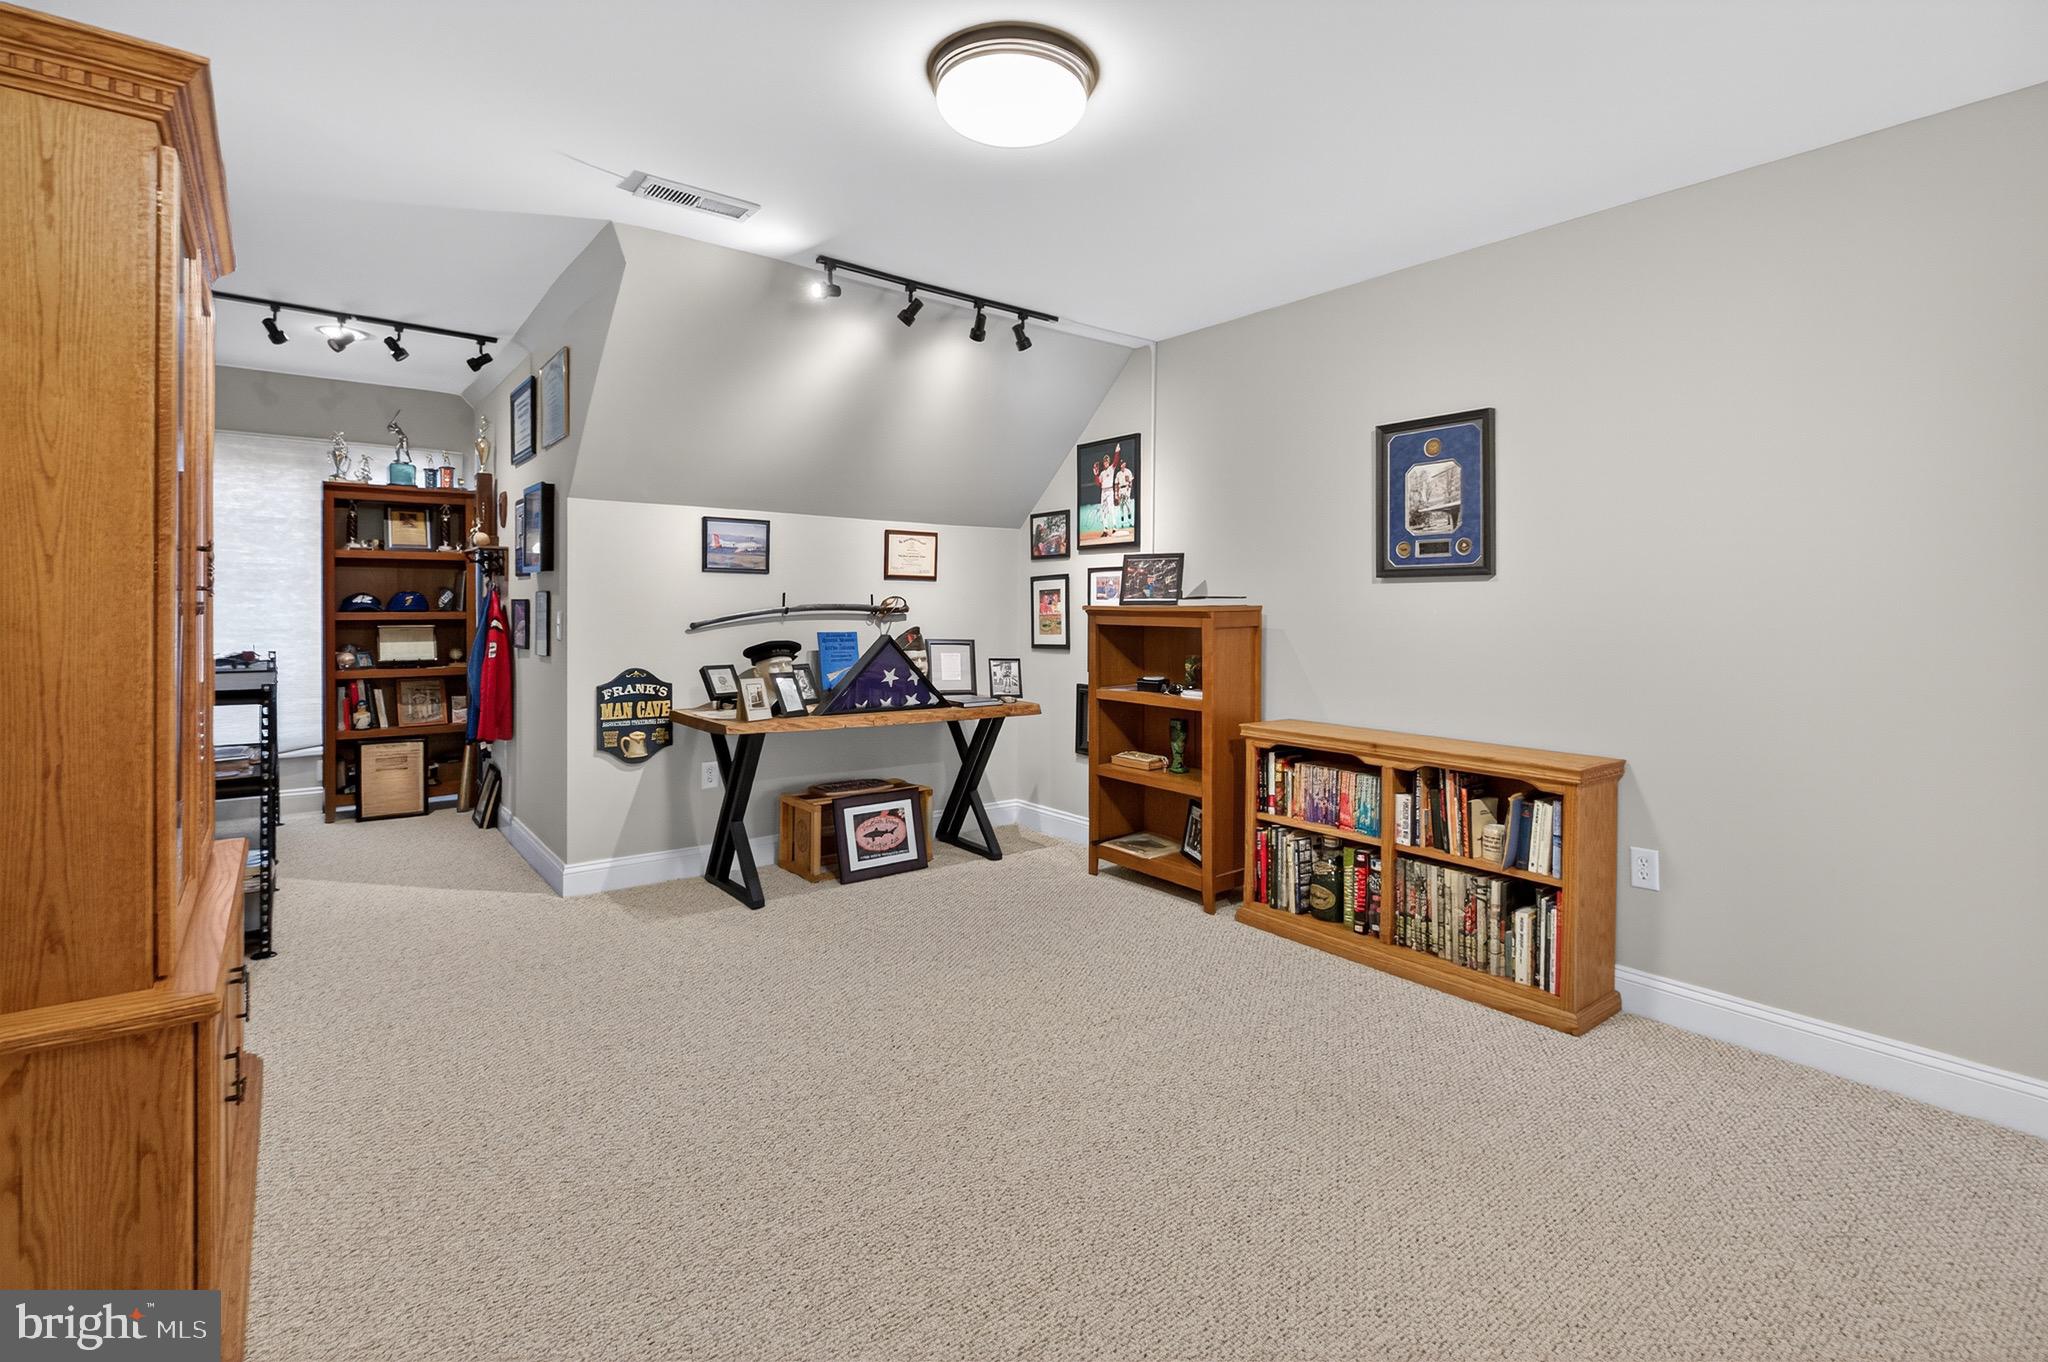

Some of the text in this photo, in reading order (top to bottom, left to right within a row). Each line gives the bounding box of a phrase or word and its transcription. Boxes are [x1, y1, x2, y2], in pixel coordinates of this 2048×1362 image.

[602, 684, 668, 700] FRANK'S
[600, 700, 670, 720] MAN CAVE
